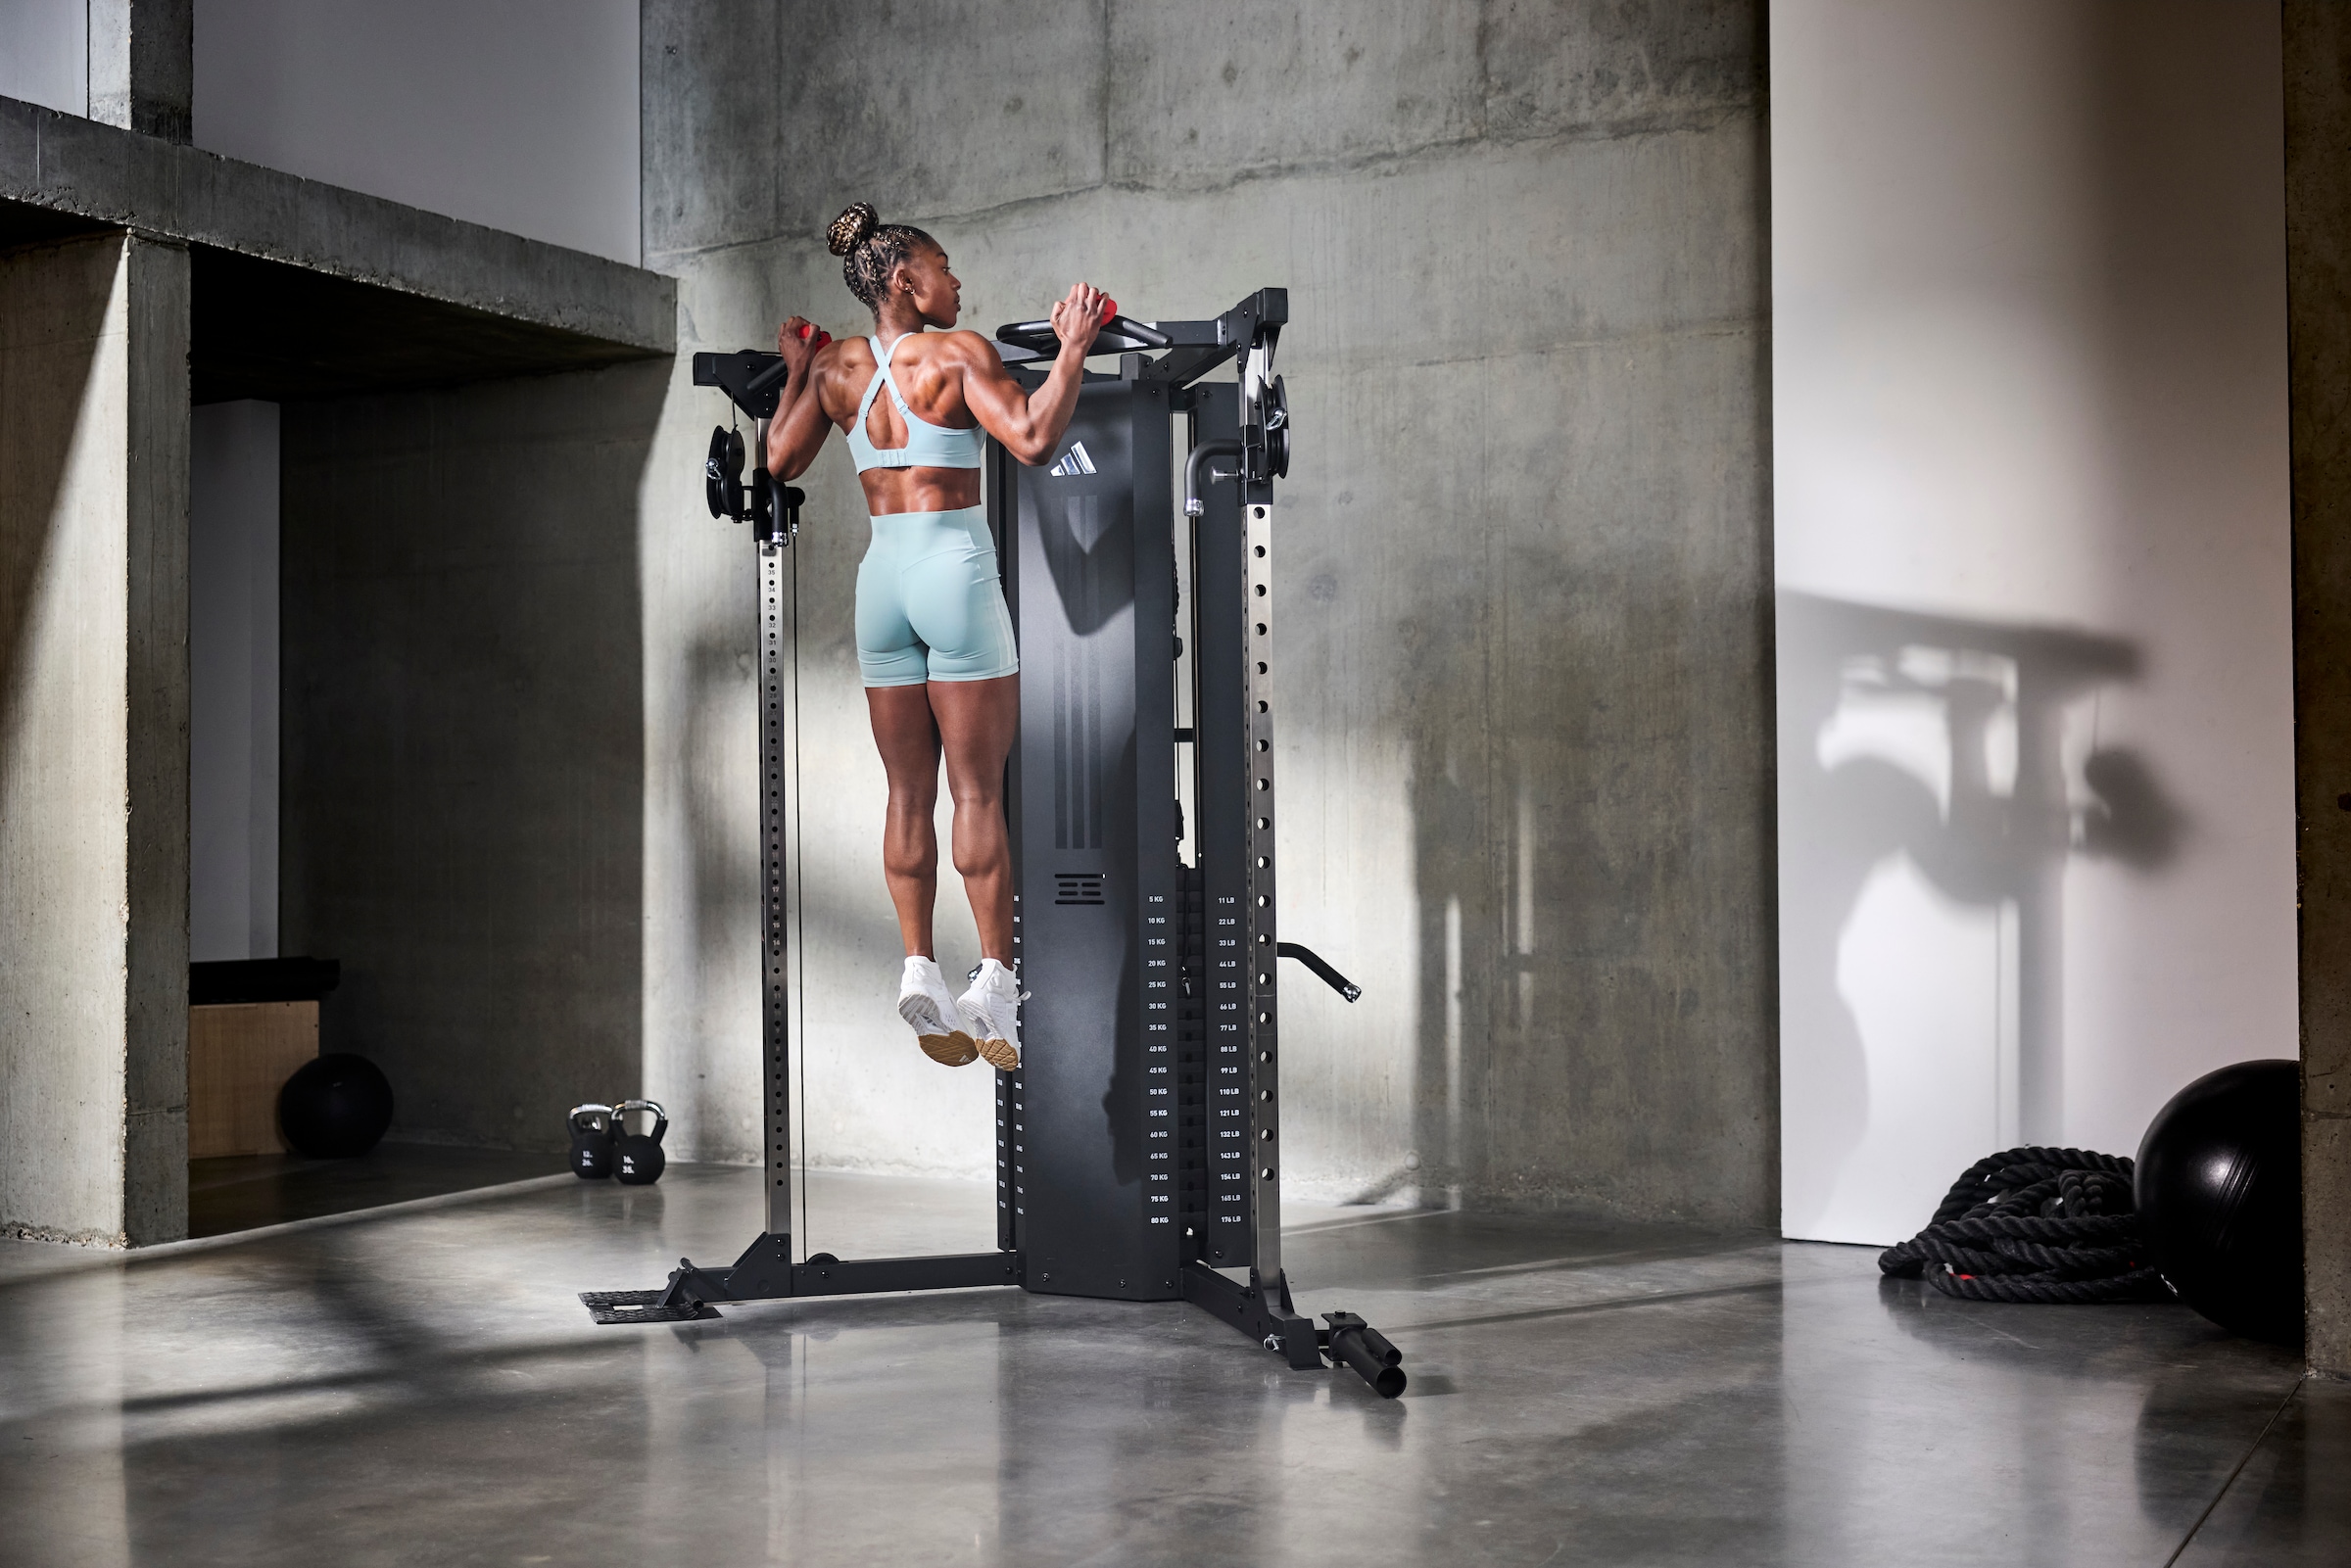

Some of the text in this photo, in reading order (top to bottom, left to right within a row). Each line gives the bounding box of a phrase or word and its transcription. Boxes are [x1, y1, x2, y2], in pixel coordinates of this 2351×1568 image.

[1147, 959, 1167, 968] 20 KG
[1219, 1002, 1237, 1011] 66 LB
[1149, 1087, 1168, 1096] 50 KG
[1219, 1087, 1240, 1096] 110 LB
[1149, 1109, 1169, 1117] 55 KG
[1219, 1109, 1240, 1117] 121 LB
[1149, 1130, 1169, 1139] 60 KG
[1220, 1151, 1241, 1160] 143 LB
[1220, 1172, 1241, 1181] 154 LB
